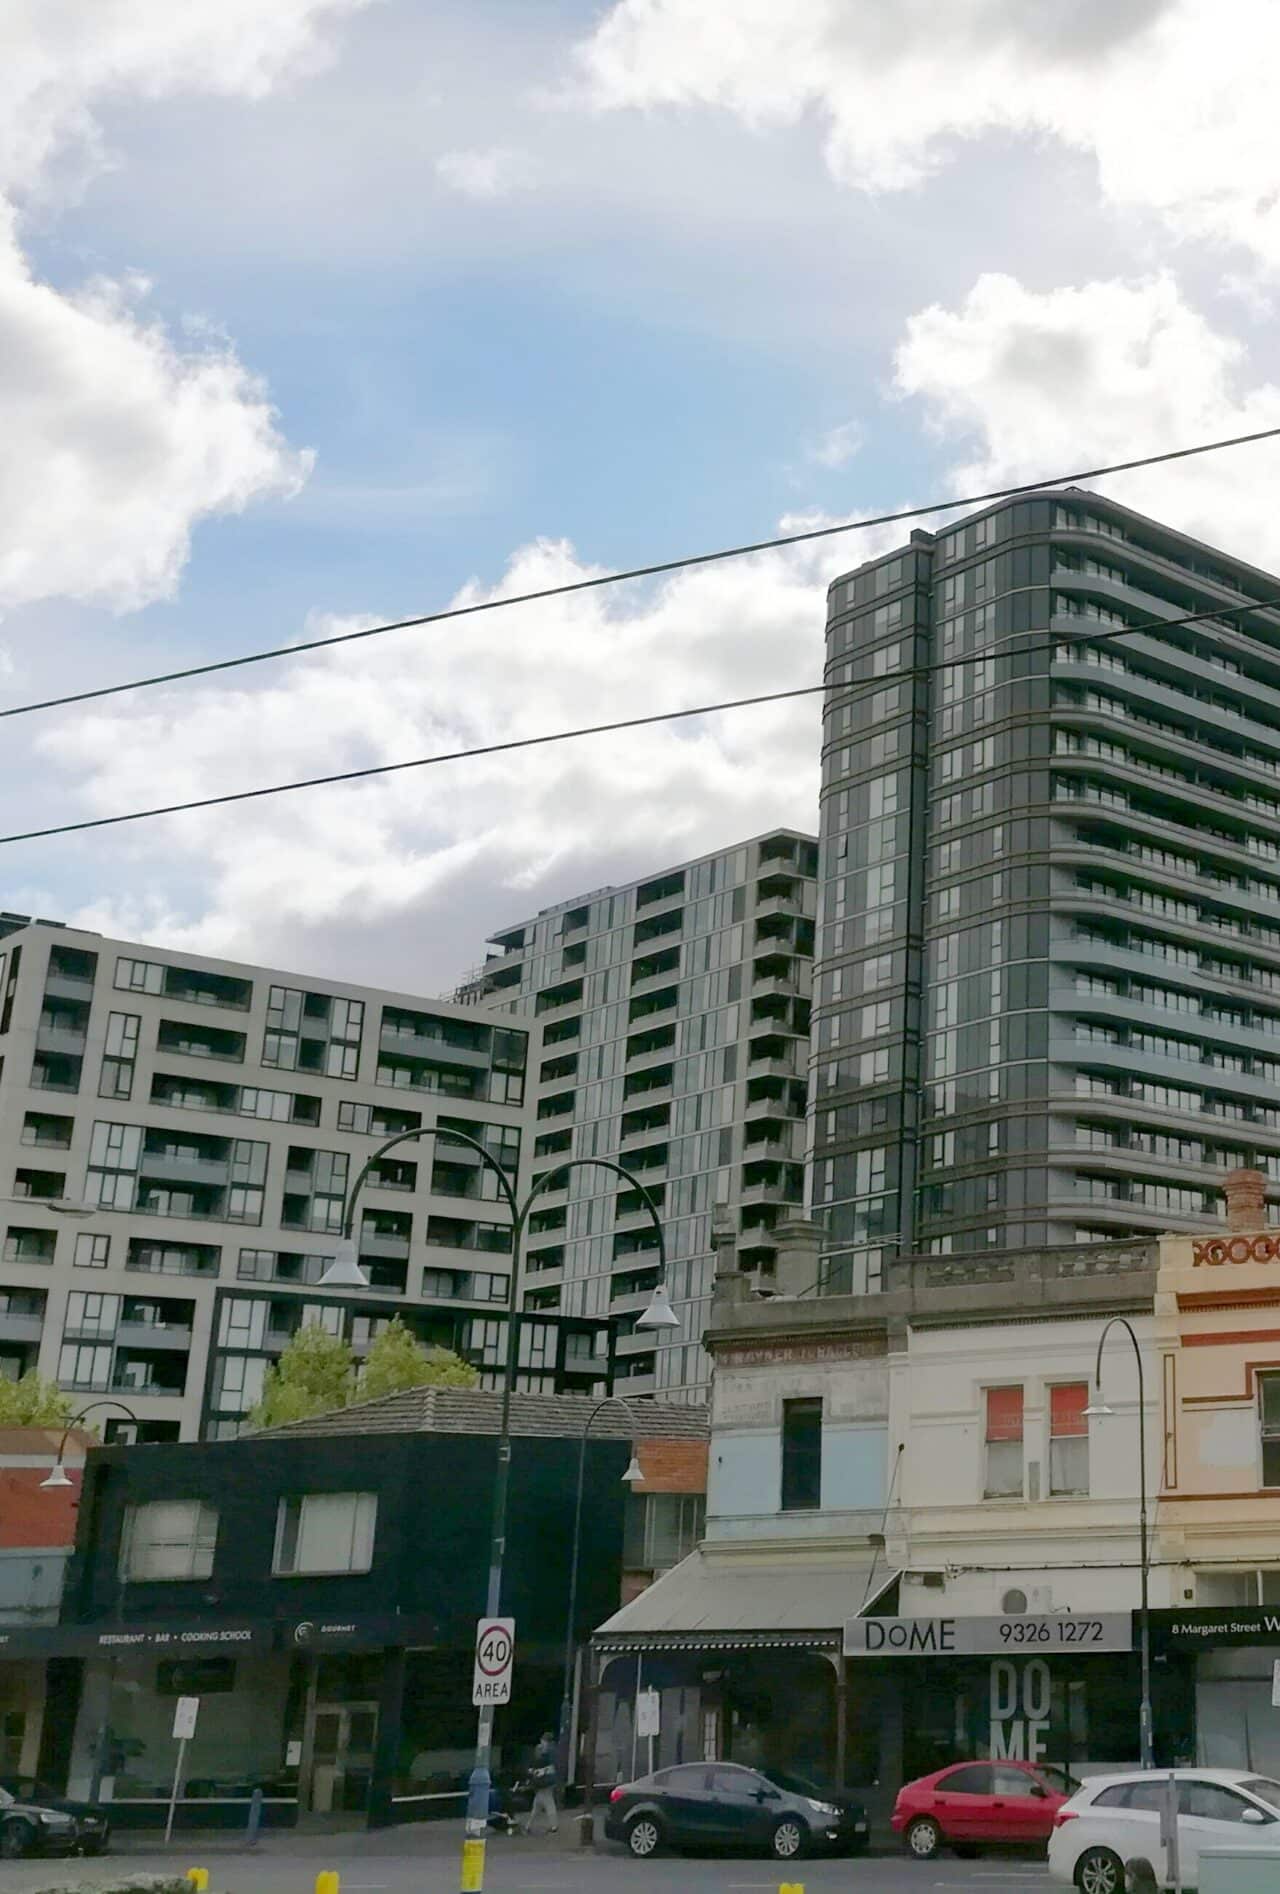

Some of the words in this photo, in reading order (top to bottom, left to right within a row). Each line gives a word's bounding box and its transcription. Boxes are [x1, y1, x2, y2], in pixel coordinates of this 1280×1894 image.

[99, 1633, 145, 1645] RESTAURANT
[181, 1631, 218, 1642] COOKING
[219, 1630, 252, 1641] SCHOOL
[999, 1623, 1051, 1643] 9326
[1057, 1622, 1104, 1642] 1272
[1171, 1624, 1179, 1634] 8
[1181, 1624, 1228, 1637] Margaret
[1230, 1622, 1262, 1633] Street
[482, 1640, 507, 1662] 40
[475, 1682, 508, 1698] AREA
